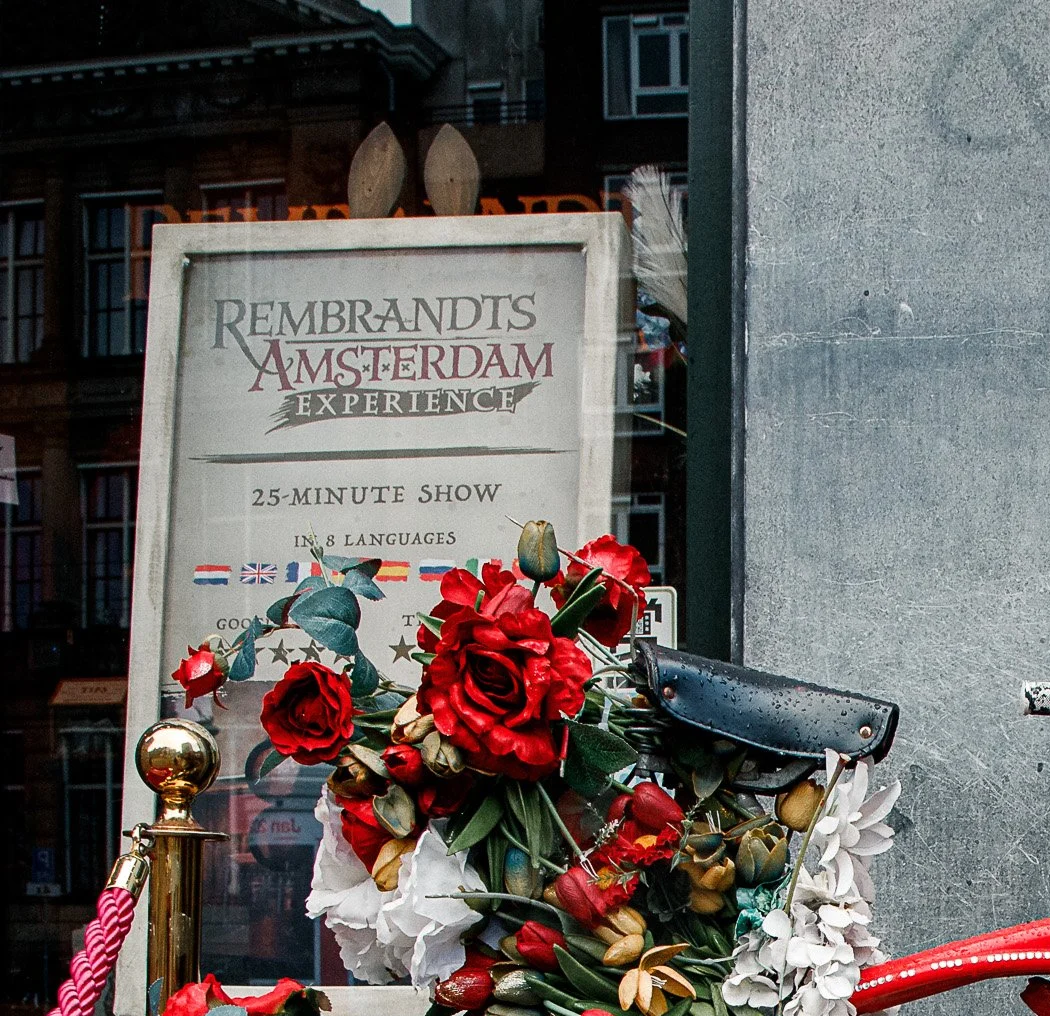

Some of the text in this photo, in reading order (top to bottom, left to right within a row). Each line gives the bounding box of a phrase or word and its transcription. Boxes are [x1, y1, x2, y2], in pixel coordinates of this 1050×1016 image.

[212, 292, 538, 350] REMBRANDTS
[248, 338, 555, 392] AMSTERDAM
[295, 386, 517, 417] EXPERIENCE
[251, 483, 503, 507] 25-MINUTE SHOW
[294, 531, 457, 548] IN 8 LANGUAGES
